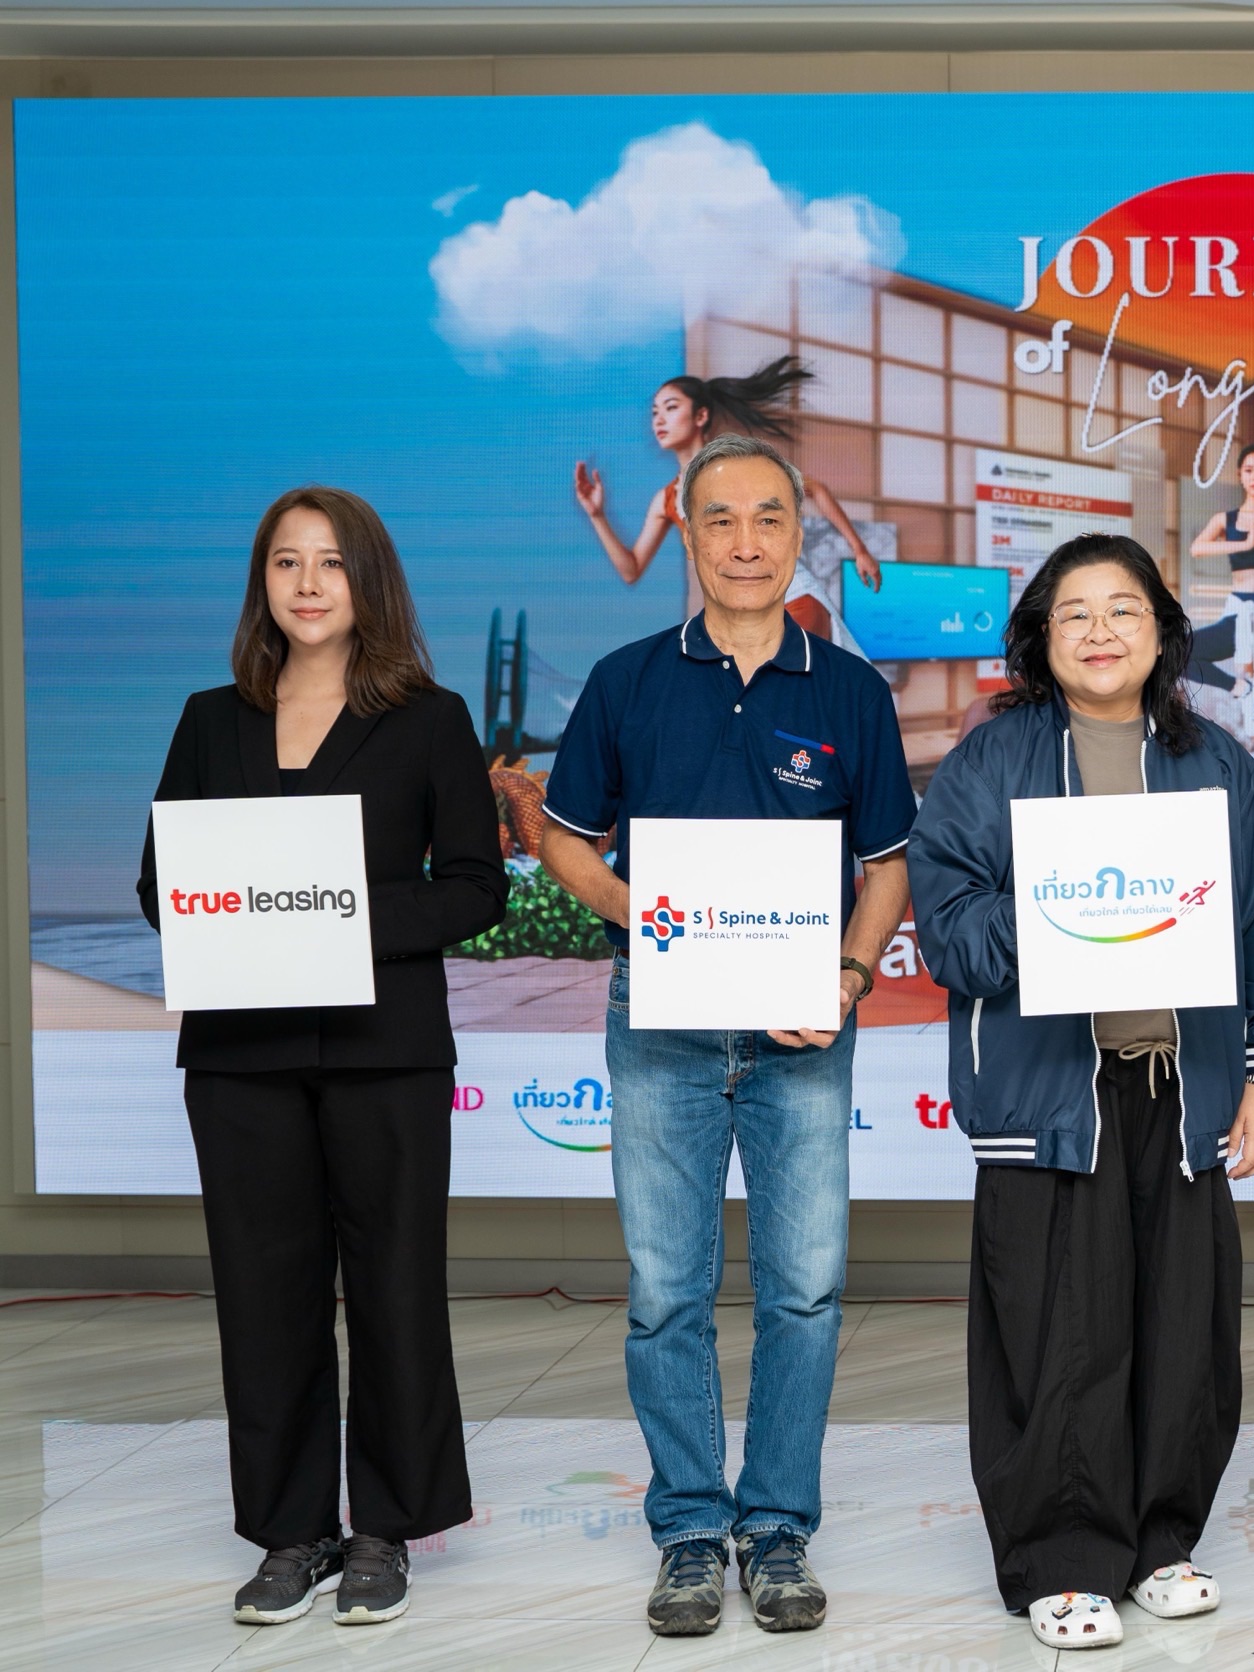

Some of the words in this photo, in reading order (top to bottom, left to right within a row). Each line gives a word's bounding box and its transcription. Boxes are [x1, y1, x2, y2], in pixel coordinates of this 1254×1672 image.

[1013, 318, 1073, 374] of
[991, 487, 1033, 505] DAILY
[1037, 492, 1092, 511] REPORT
[782, 770, 800, 780] Spine
[805, 777, 823, 787] Joint
[1033, 866, 1175, 901] เที่ยวกลาง
[169, 888, 242, 915] true
[247, 884, 357, 918] leasing
[693, 910, 703, 925] S
[719, 910, 767, 928] Spine
[769, 911, 782, 925] &
[785, 911, 830, 926] Joint
[693, 932, 741, 940] SPECIALTY
[745, 932, 790, 940] HOSPITAL
